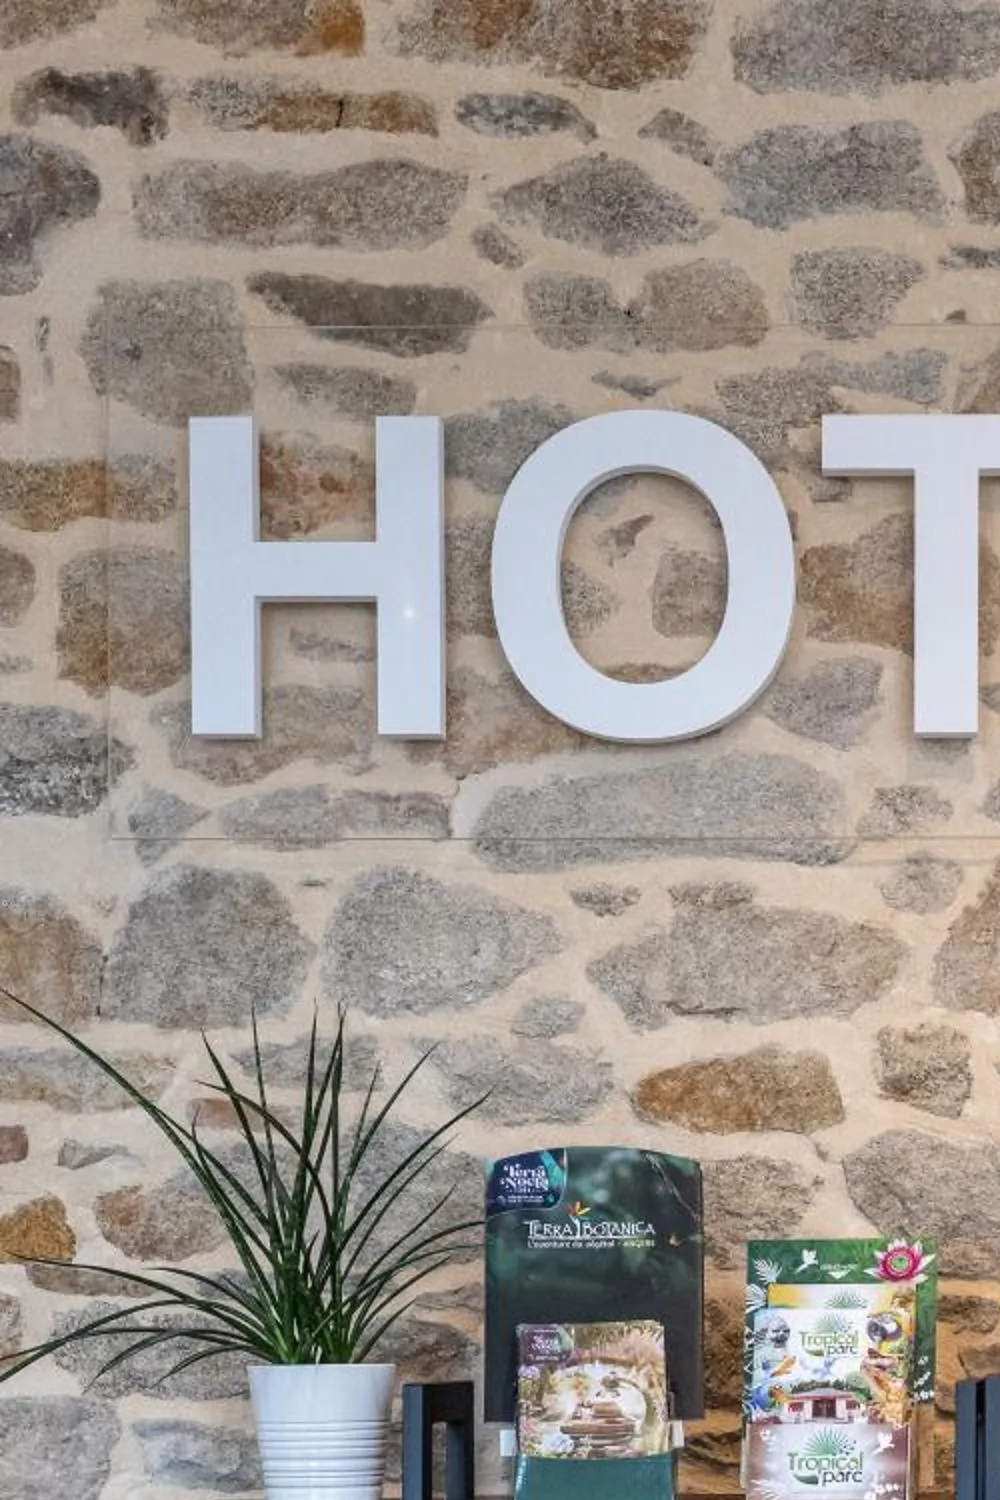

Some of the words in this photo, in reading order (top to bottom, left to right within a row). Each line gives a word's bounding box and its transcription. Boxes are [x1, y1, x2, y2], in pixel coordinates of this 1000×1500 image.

[524, 1219, 574, 1235] TERRA
[583, 1221, 656, 1236] BOTANICA
[799, 1331, 859, 1350] Tropical
[826, 1345, 858, 1358] parc
[787, 1451, 864, 1473] Tropical
[822, 1469, 863, 1487] parc
